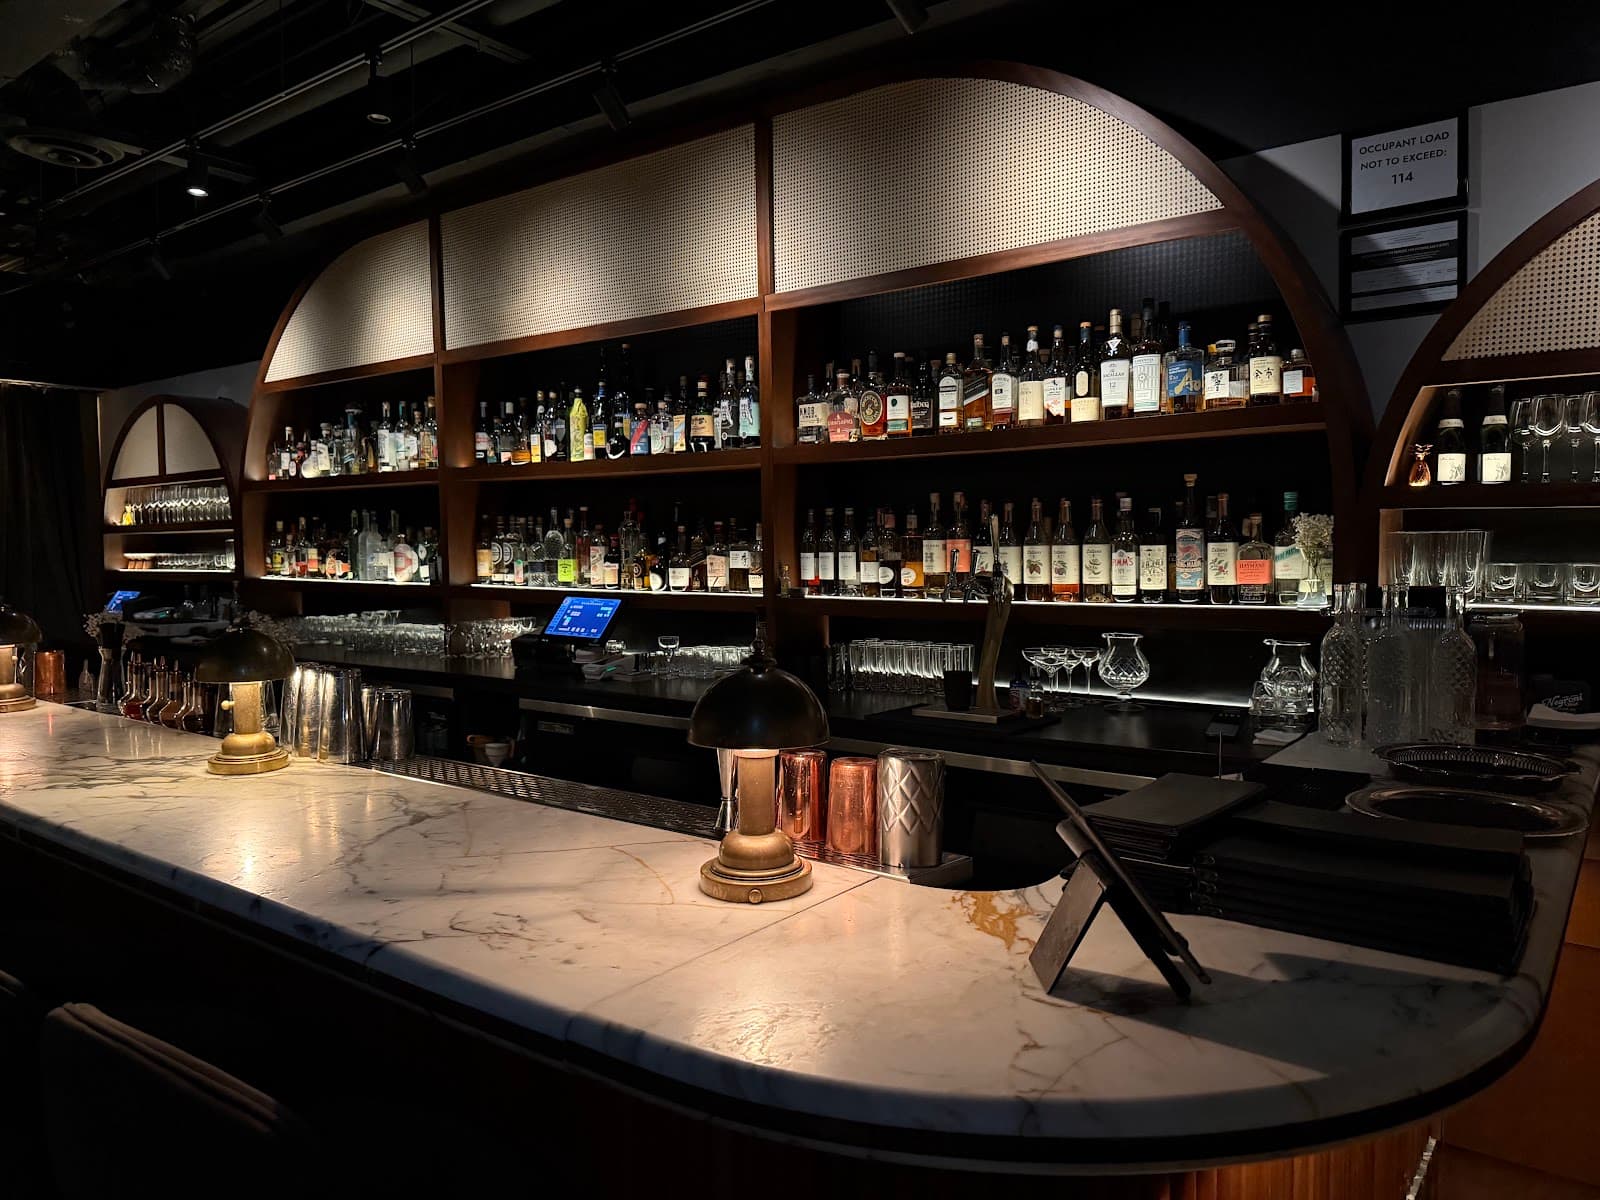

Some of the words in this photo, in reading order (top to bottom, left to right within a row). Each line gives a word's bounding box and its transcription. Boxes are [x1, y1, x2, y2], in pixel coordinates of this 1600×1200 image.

[1359, 137, 1416, 155] OCCUPANT
[1420, 131, 1450, 144] LOAD
[1360, 159, 1383, 170] NOT
[1386, 157, 1400, 166] TO
[1403, 149, 1447, 163] EXCEED:
[1391, 171, 1414, 184] 114
[1542, 692, 1583, 708] Negroni
